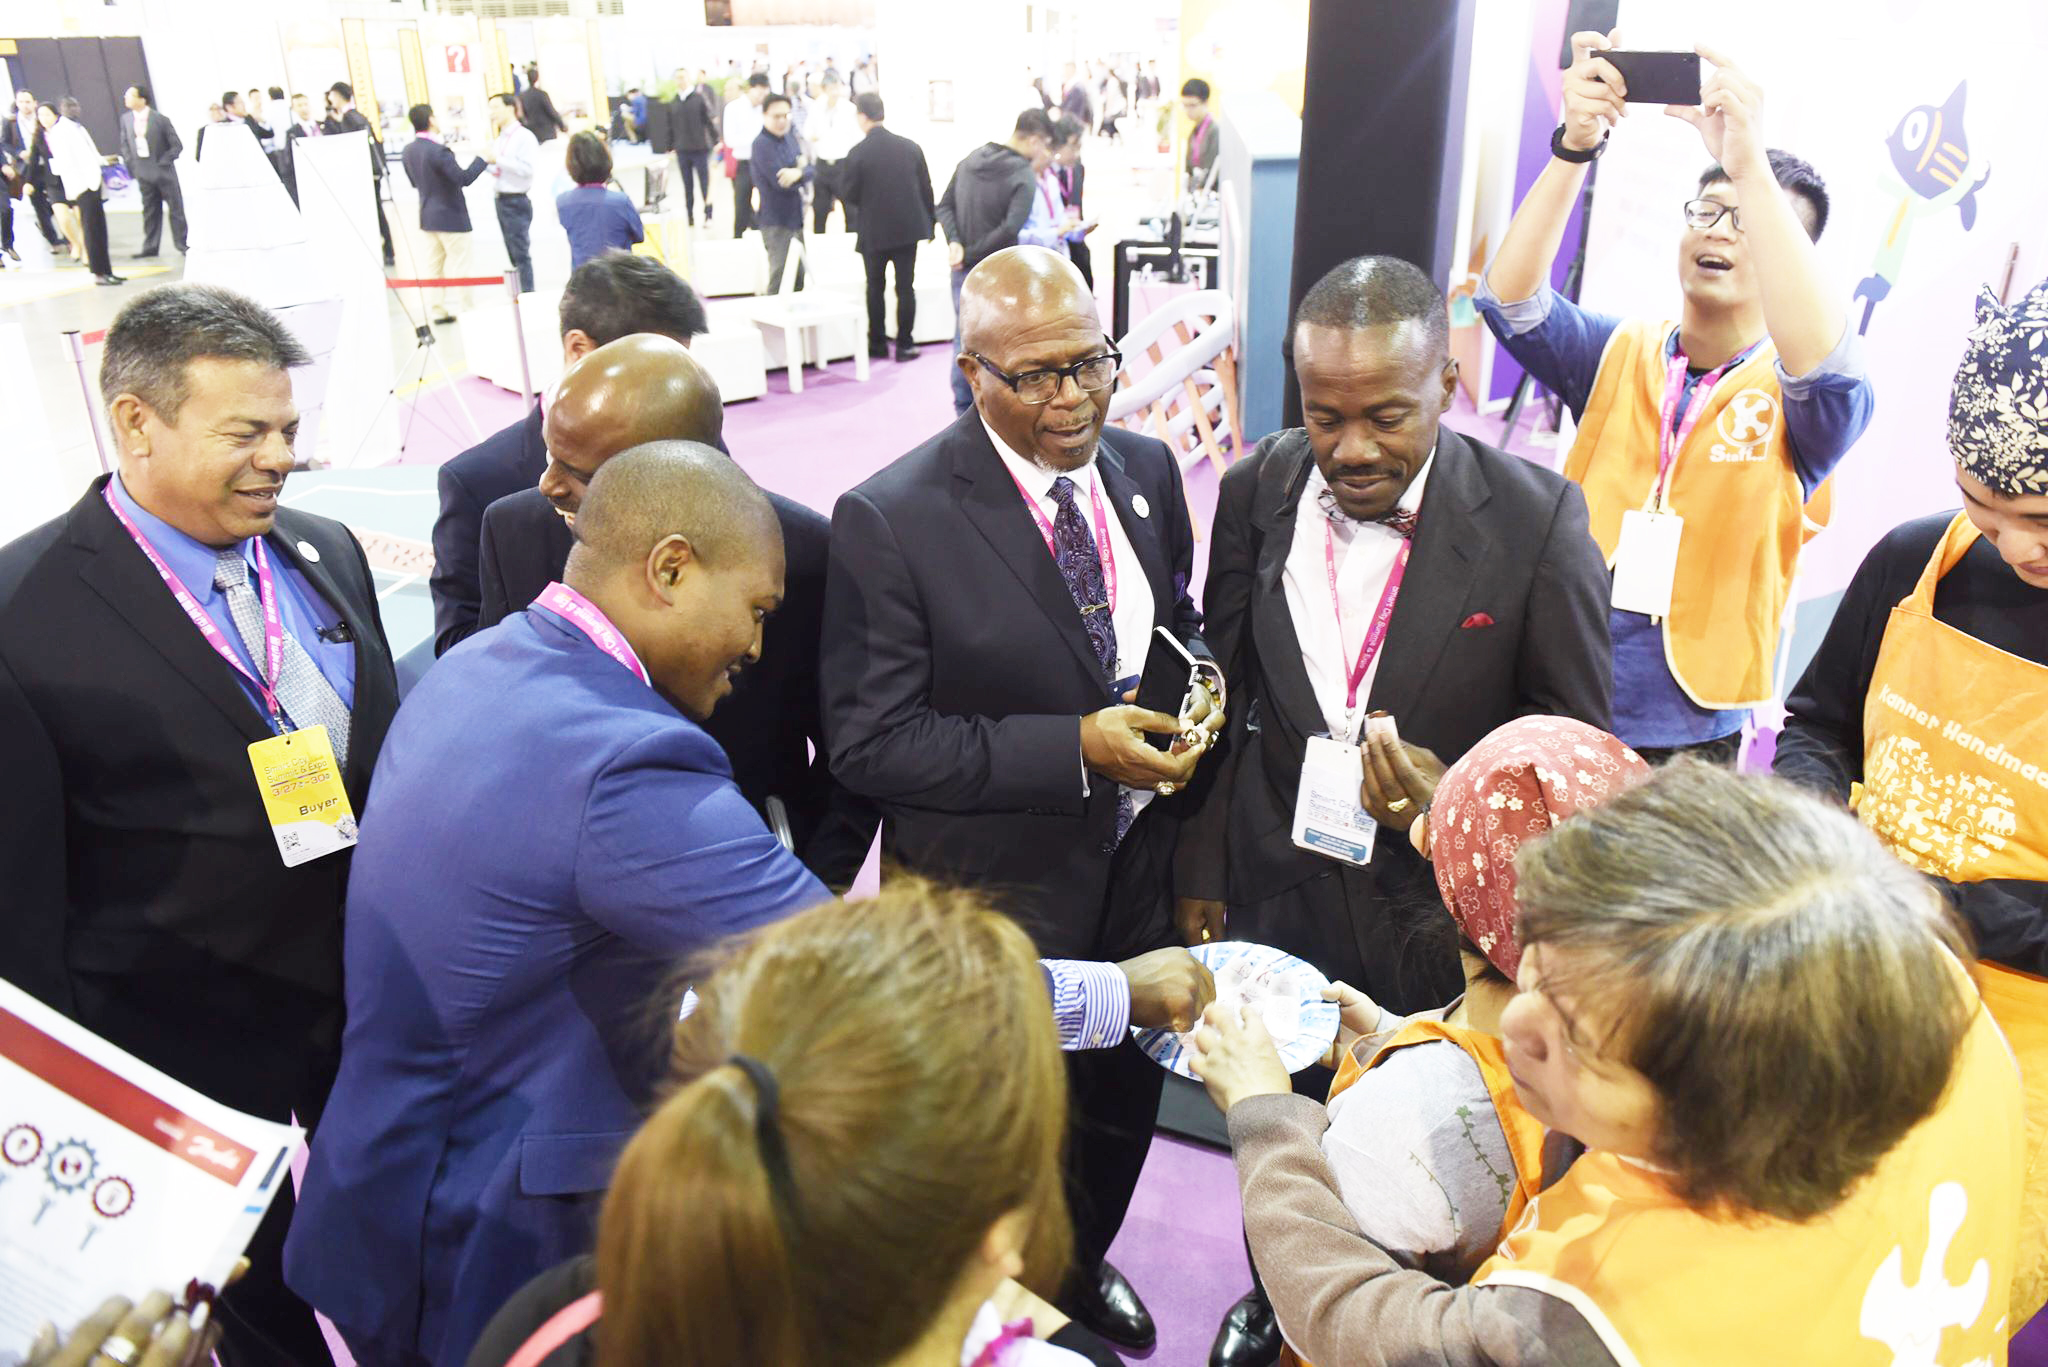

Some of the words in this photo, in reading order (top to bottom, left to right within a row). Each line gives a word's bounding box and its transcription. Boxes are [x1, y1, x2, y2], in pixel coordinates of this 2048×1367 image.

[1878, 683, 1940, 730] Kanner
[299, 797, 338, 816] Buyer
[1310, 790, 1336, 806] Smart
